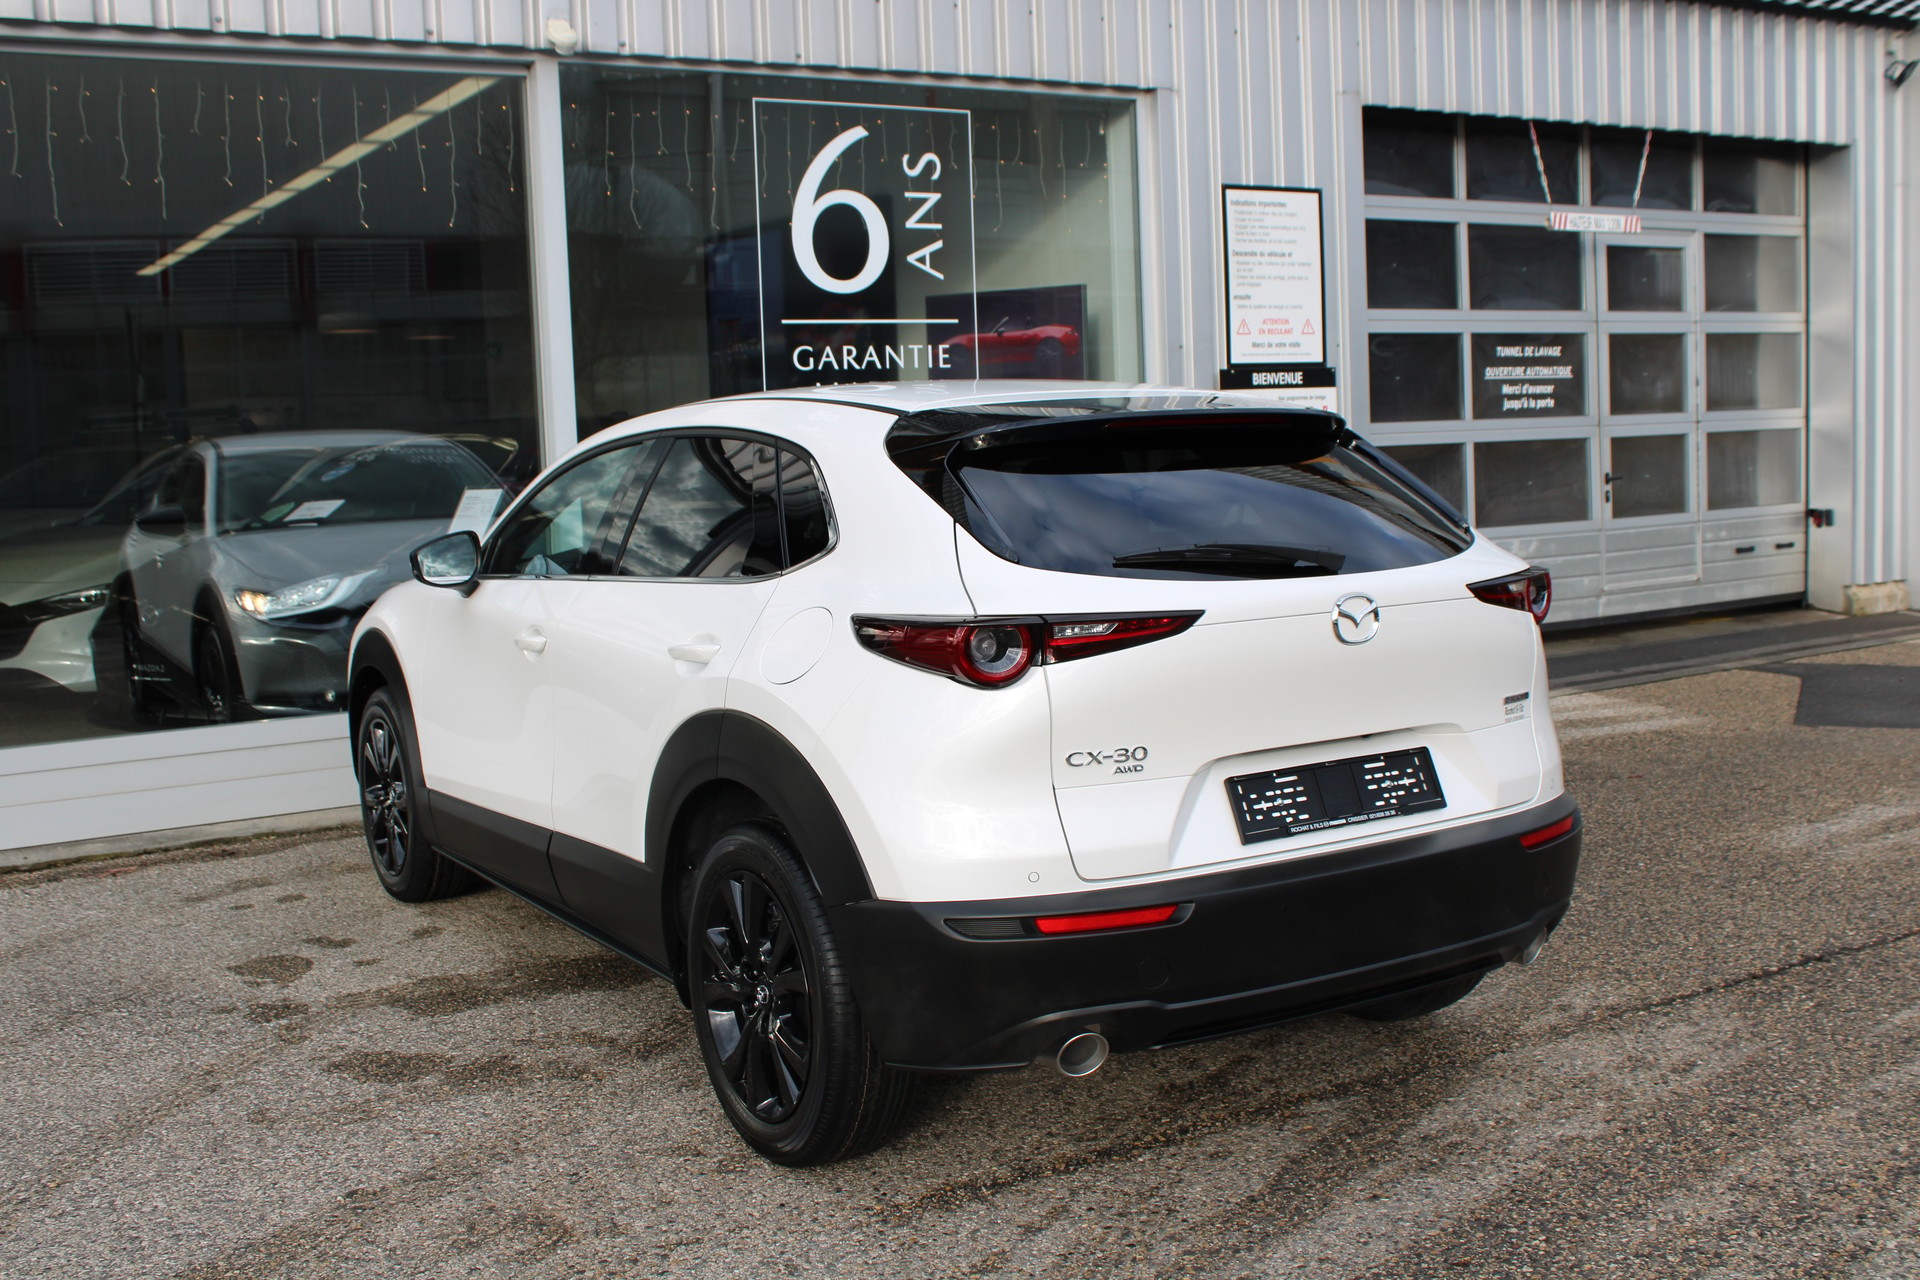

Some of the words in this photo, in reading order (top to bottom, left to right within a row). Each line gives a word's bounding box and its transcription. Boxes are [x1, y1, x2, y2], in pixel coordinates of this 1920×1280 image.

[791, 125, 890, 295] 6
[902, 152, 944, 280] ANS
[792, 345, 951, 371] GARANTIE
[1496, 346, 1523, 357] TUNNEL
[1523, 346, 1534, 357] DE
[1534, 346, 1562, 357] LAVAGE
[1252, 371, 1303, 385] BIENVENUE
[1484, 366, 1525, 377] OUVERTURE
[1525, 366, 1573, 377] AUTOMATIQUE
[1502, 384, 1522, 395] Merci
[1522, 384, 1555, 395] d'avancer
[1503, 397, 1528, 411] jusqu'à
[1528, 397, 1536, 409] la
[1536, 397, 1555, 410] porte
[1065, 746, 1148, 767] CX-30
[1112, 764, 1144, 775] AWD
[1290, 824, 1310, 833] ROCHAT
